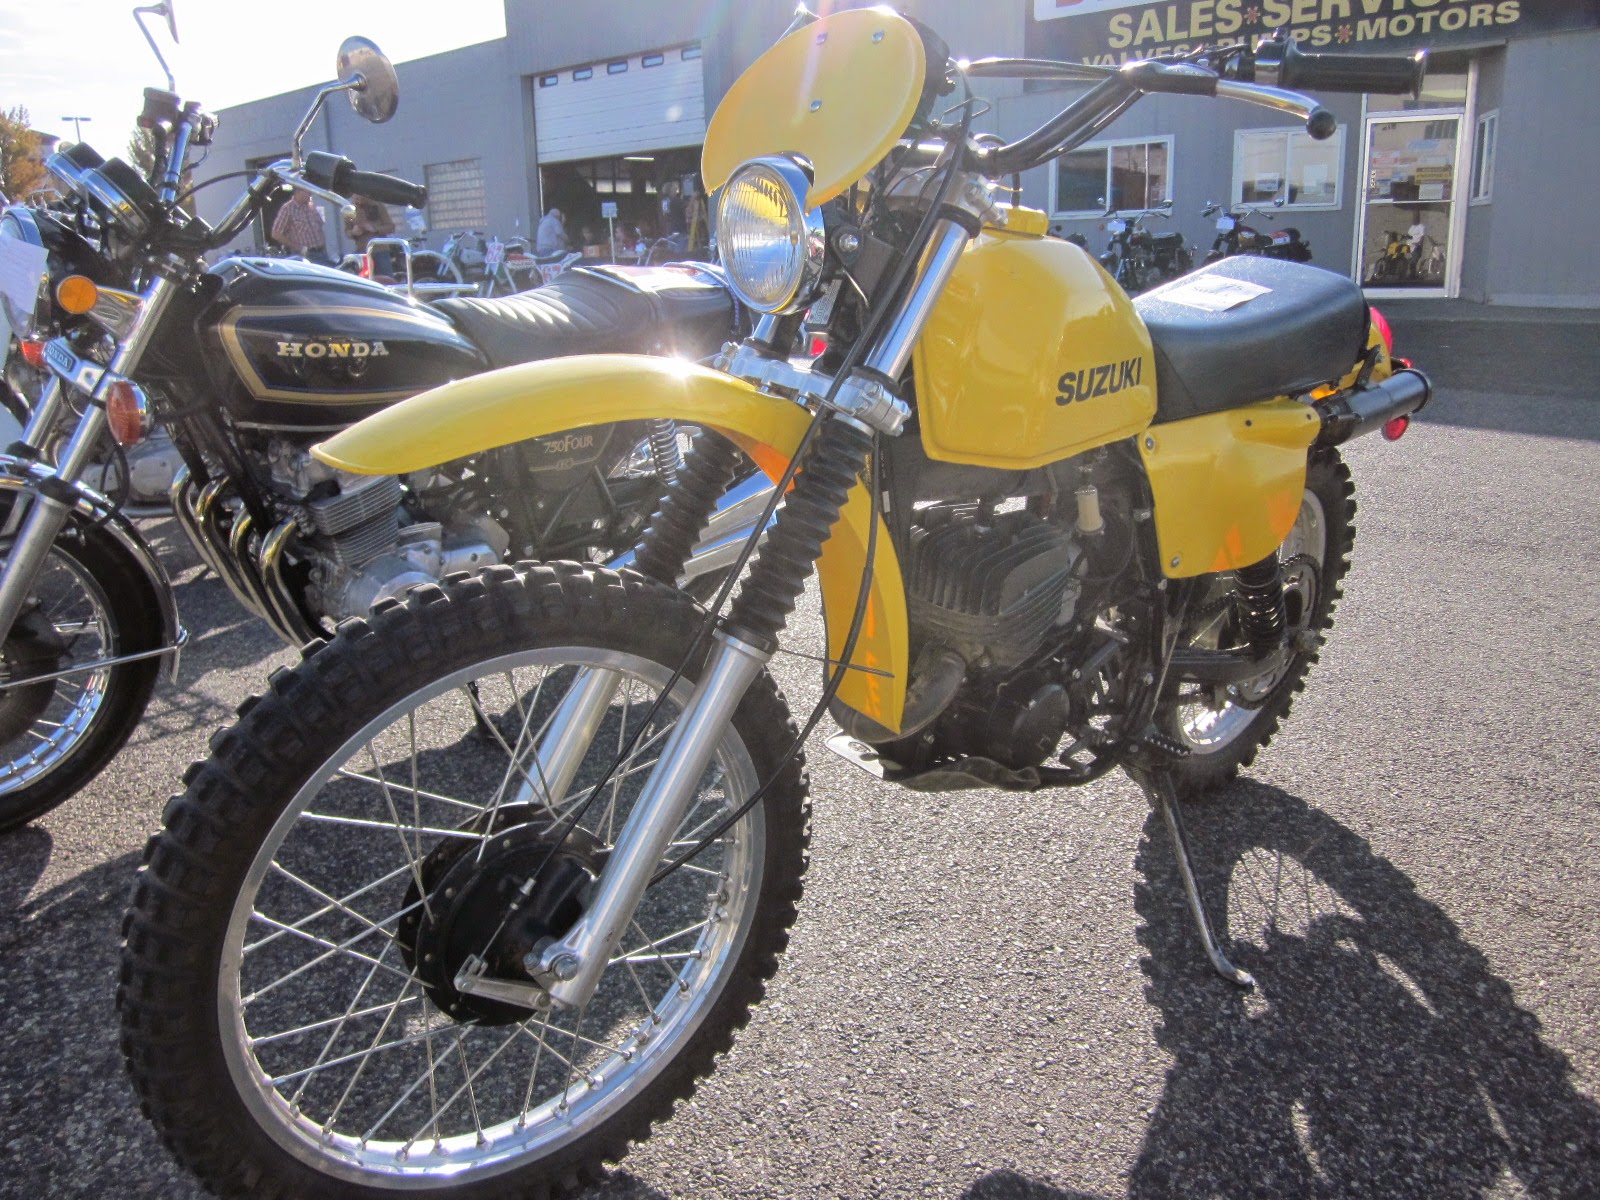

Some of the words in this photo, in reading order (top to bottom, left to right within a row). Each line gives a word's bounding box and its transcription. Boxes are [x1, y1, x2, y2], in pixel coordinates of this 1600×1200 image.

[1108, 1, 1243, 48] SALES
[1262, 0, 1466, 28] SERV
[1356, 1, 1520, 42] MOTORS
[277, 341, 389, 358] HONDA
[1055, 357, 1142, 406] SUZUKI
